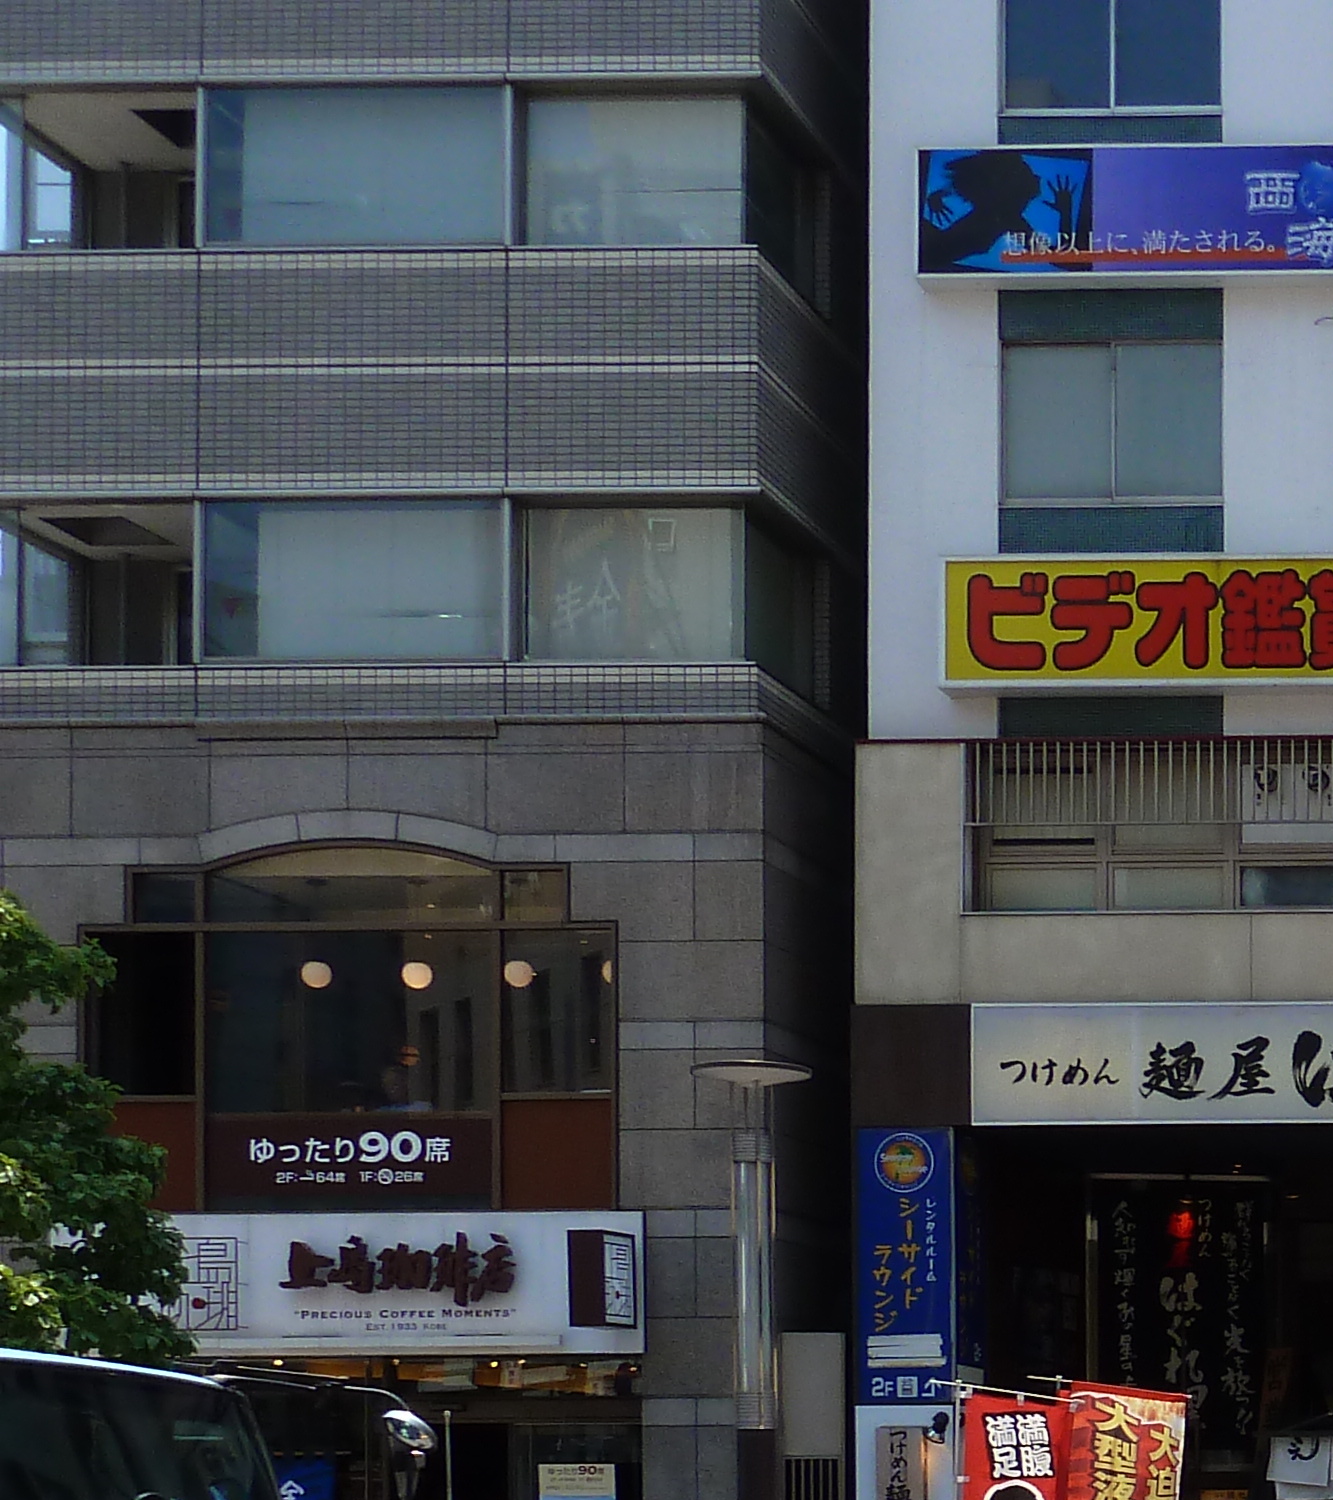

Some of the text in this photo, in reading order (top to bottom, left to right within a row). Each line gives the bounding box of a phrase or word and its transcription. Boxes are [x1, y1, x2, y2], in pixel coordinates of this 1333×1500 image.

[1002, 229, 1278, 257] 想像以上に、満たされる。
[999, 1057, 1121, 1088] つけめん
[1140, 1036, 1278, 1101] 麺屋
[248, 1130, 452, 1164] ゆったり90席
[278, 1230, 517, 1307] 上島珈琲店
[898, 1197, 924, 1309] シーサイド
[926, 1198, 938, 1282] レンタルルーム
[378, 1309, 436, 1320] COFFEE
[872, 1244, 897, 1333] ラウンジ
[872, 1378, 894, 1397] 2F
[889, 1430, 907, 1484] つけめん
[985, 1416, 1018, 1478] 満足
[1018, 1414, 1053, 1477] 満腹
